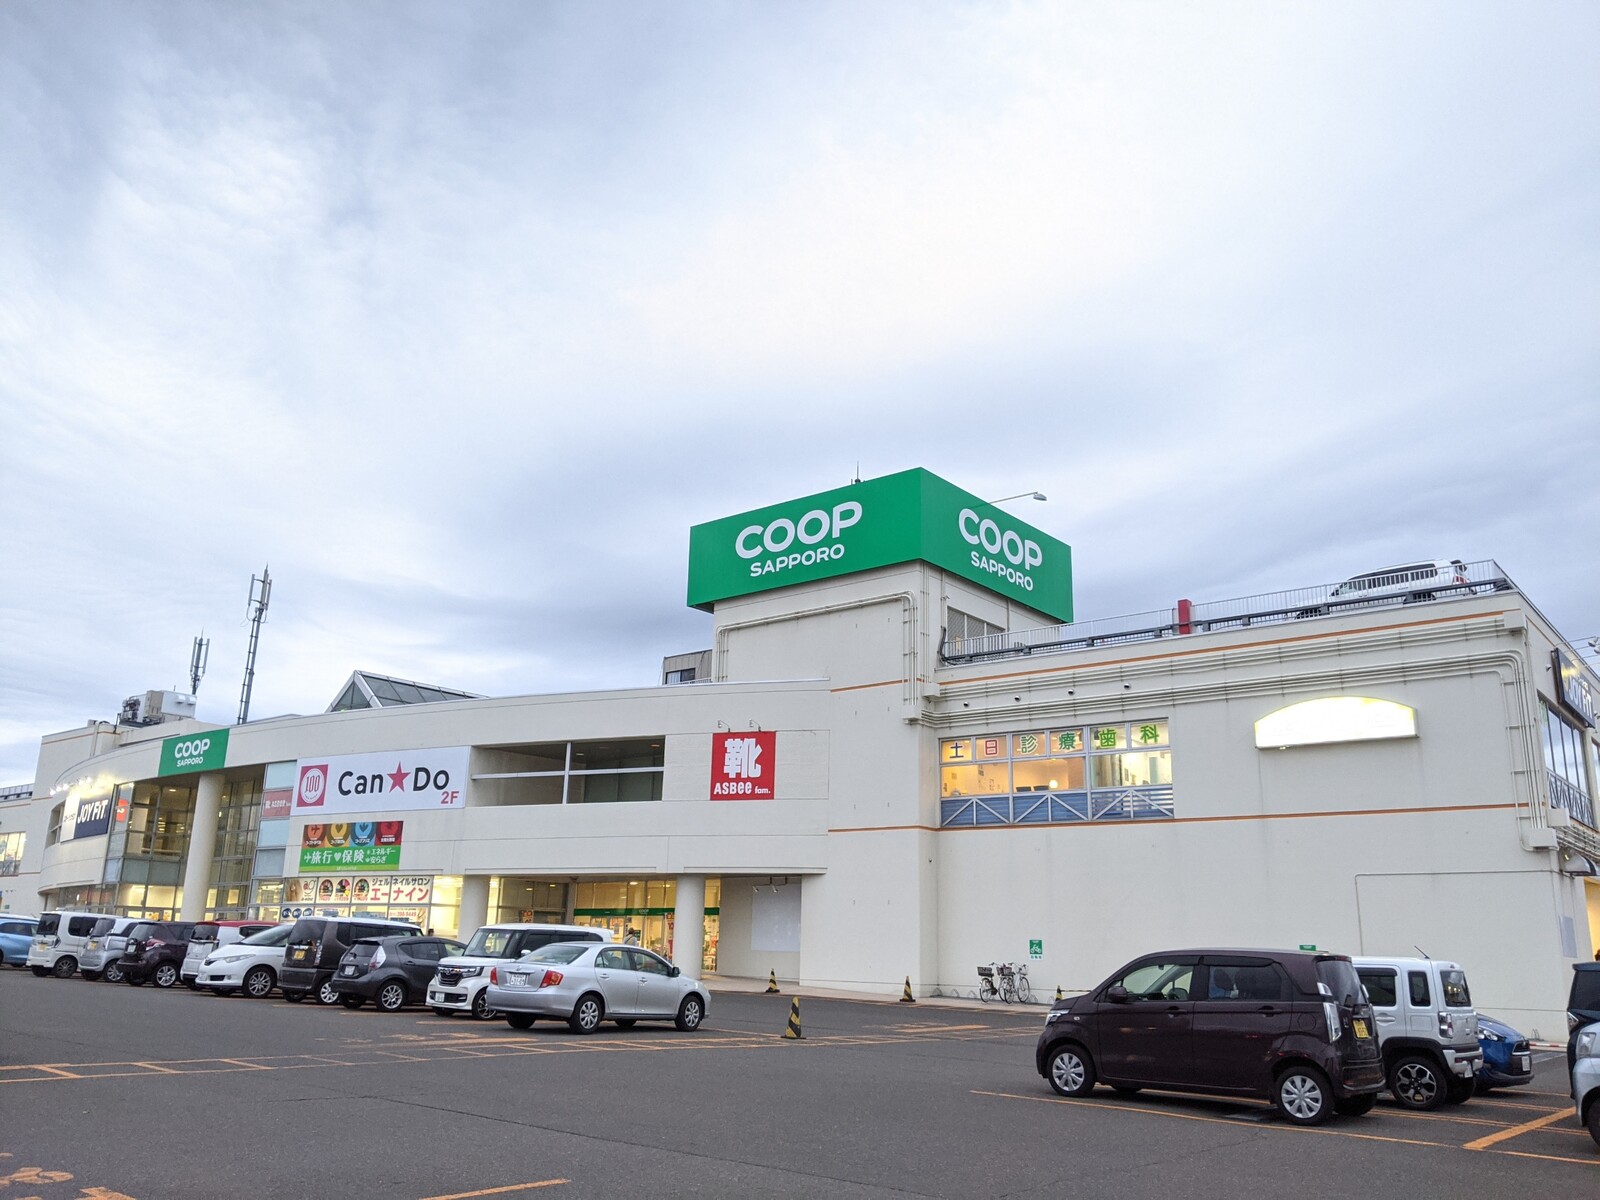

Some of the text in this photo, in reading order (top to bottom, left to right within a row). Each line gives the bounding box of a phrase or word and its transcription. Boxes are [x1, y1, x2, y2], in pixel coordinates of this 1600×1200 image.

[735, 501, 862, 559] COOP
[958, 508, 1043, 571] COOP
[750, 543, 845, 577] SAPPORO
[971, 551, 1034, 591] SAPPORO
[174, 738, 210, 758] COOP
[723, 738, 763, 778] 靴
[176, 756, 204, 767] SAPPORO
[440, 791, 459, 804] 2F
[713, 781, 752, 795] ASBee
[310, 849, 365, 864] 旅行 保険
[370, 887, 429, 901] エーナイン
